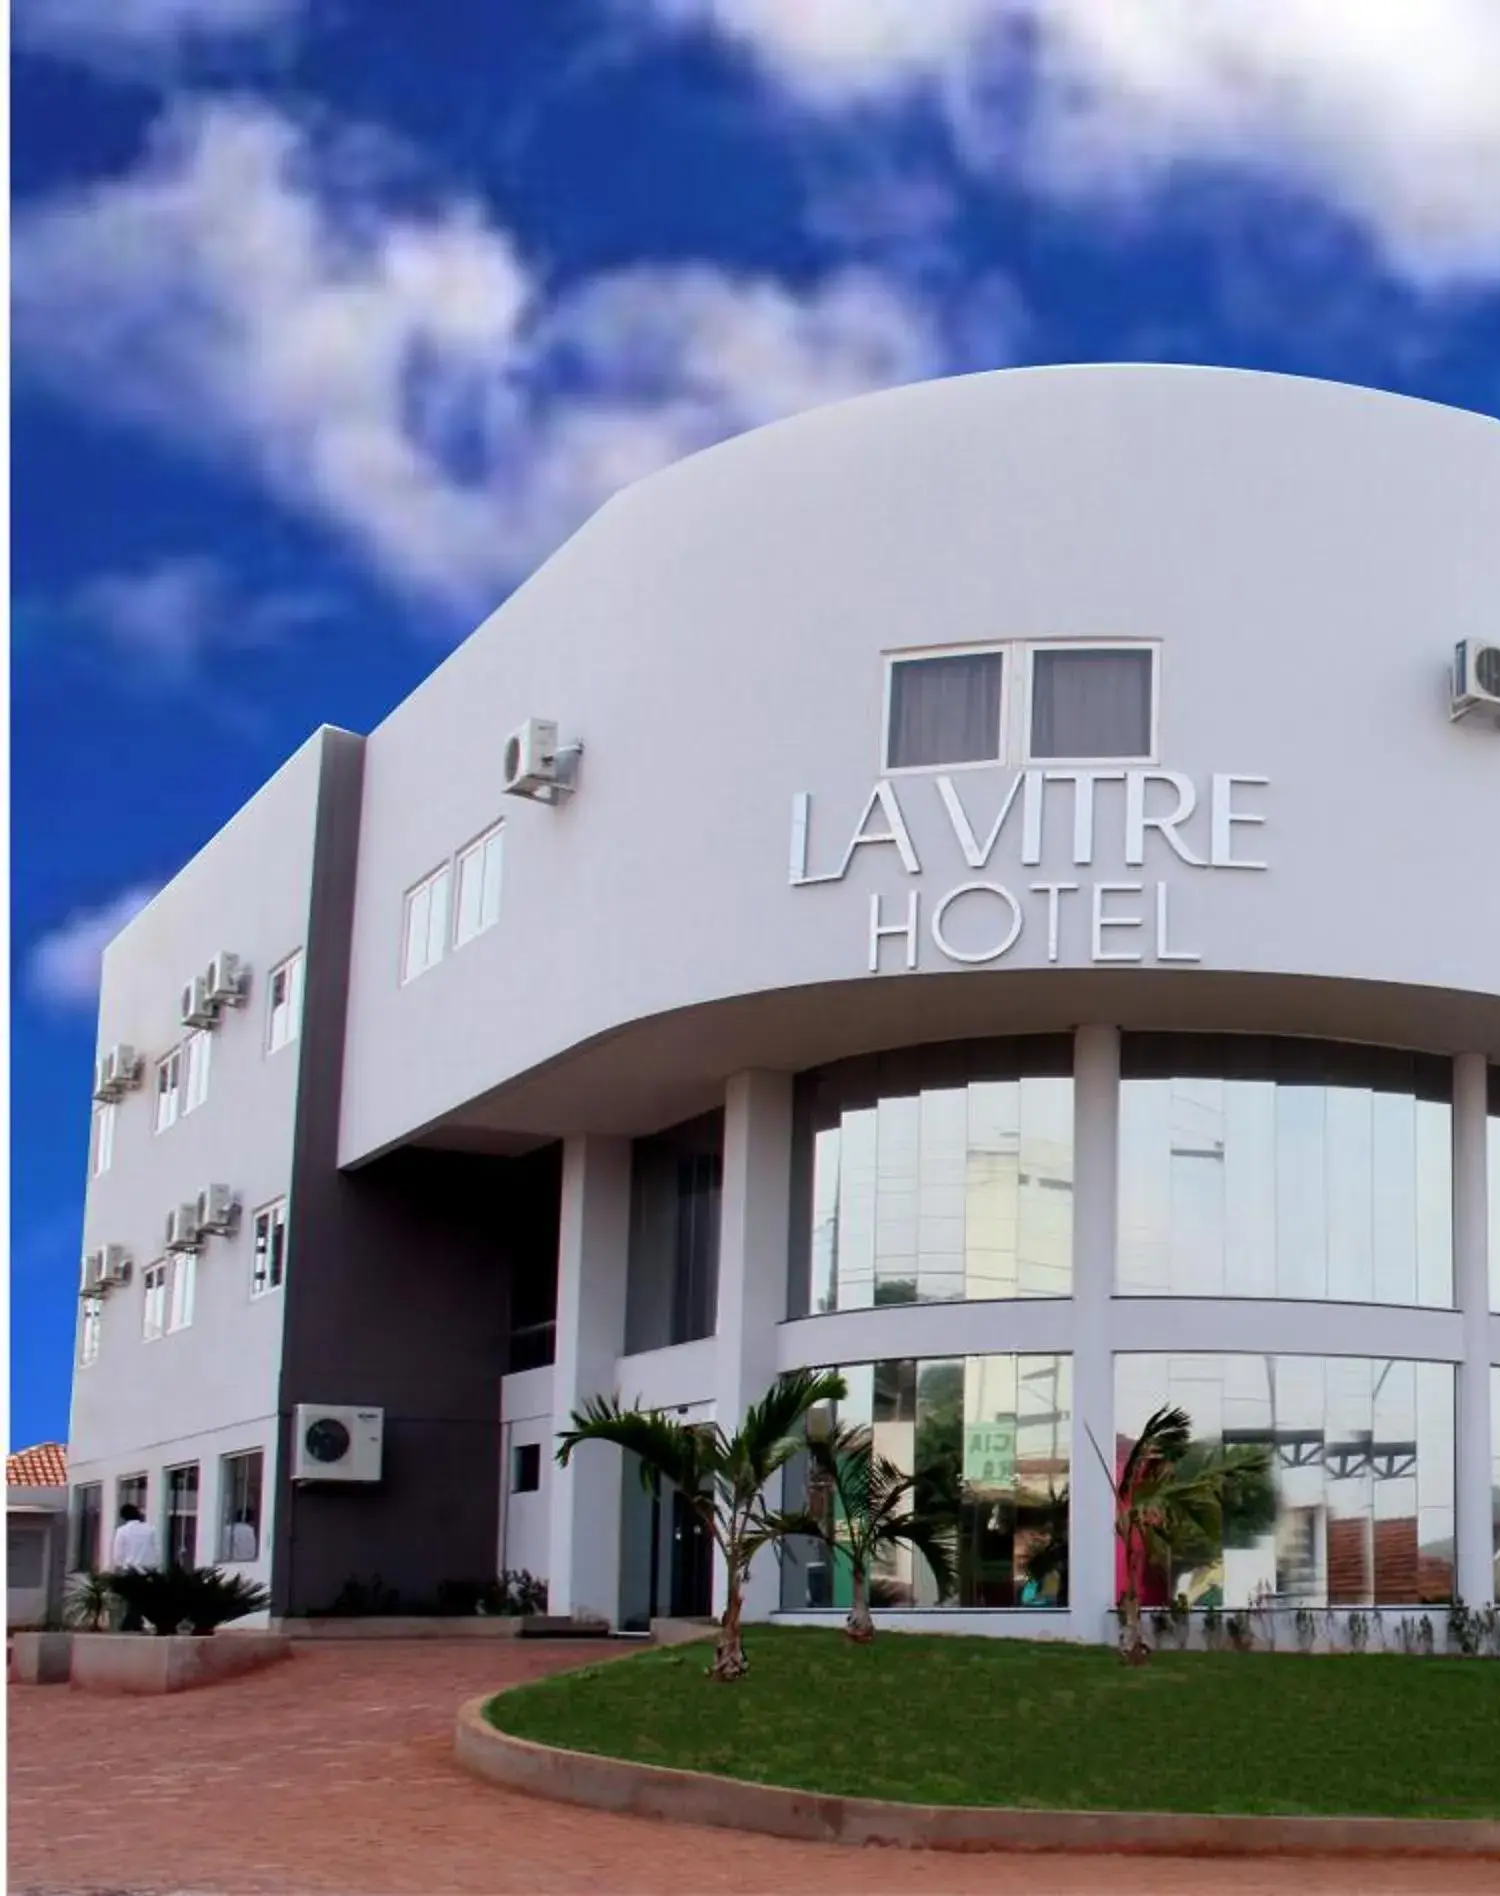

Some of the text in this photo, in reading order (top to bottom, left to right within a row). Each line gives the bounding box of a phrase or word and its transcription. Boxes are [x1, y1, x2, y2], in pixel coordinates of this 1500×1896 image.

[788, 770, 1270, 886] LA VITRE
[868, 881, 1202, 972] HOTEL
